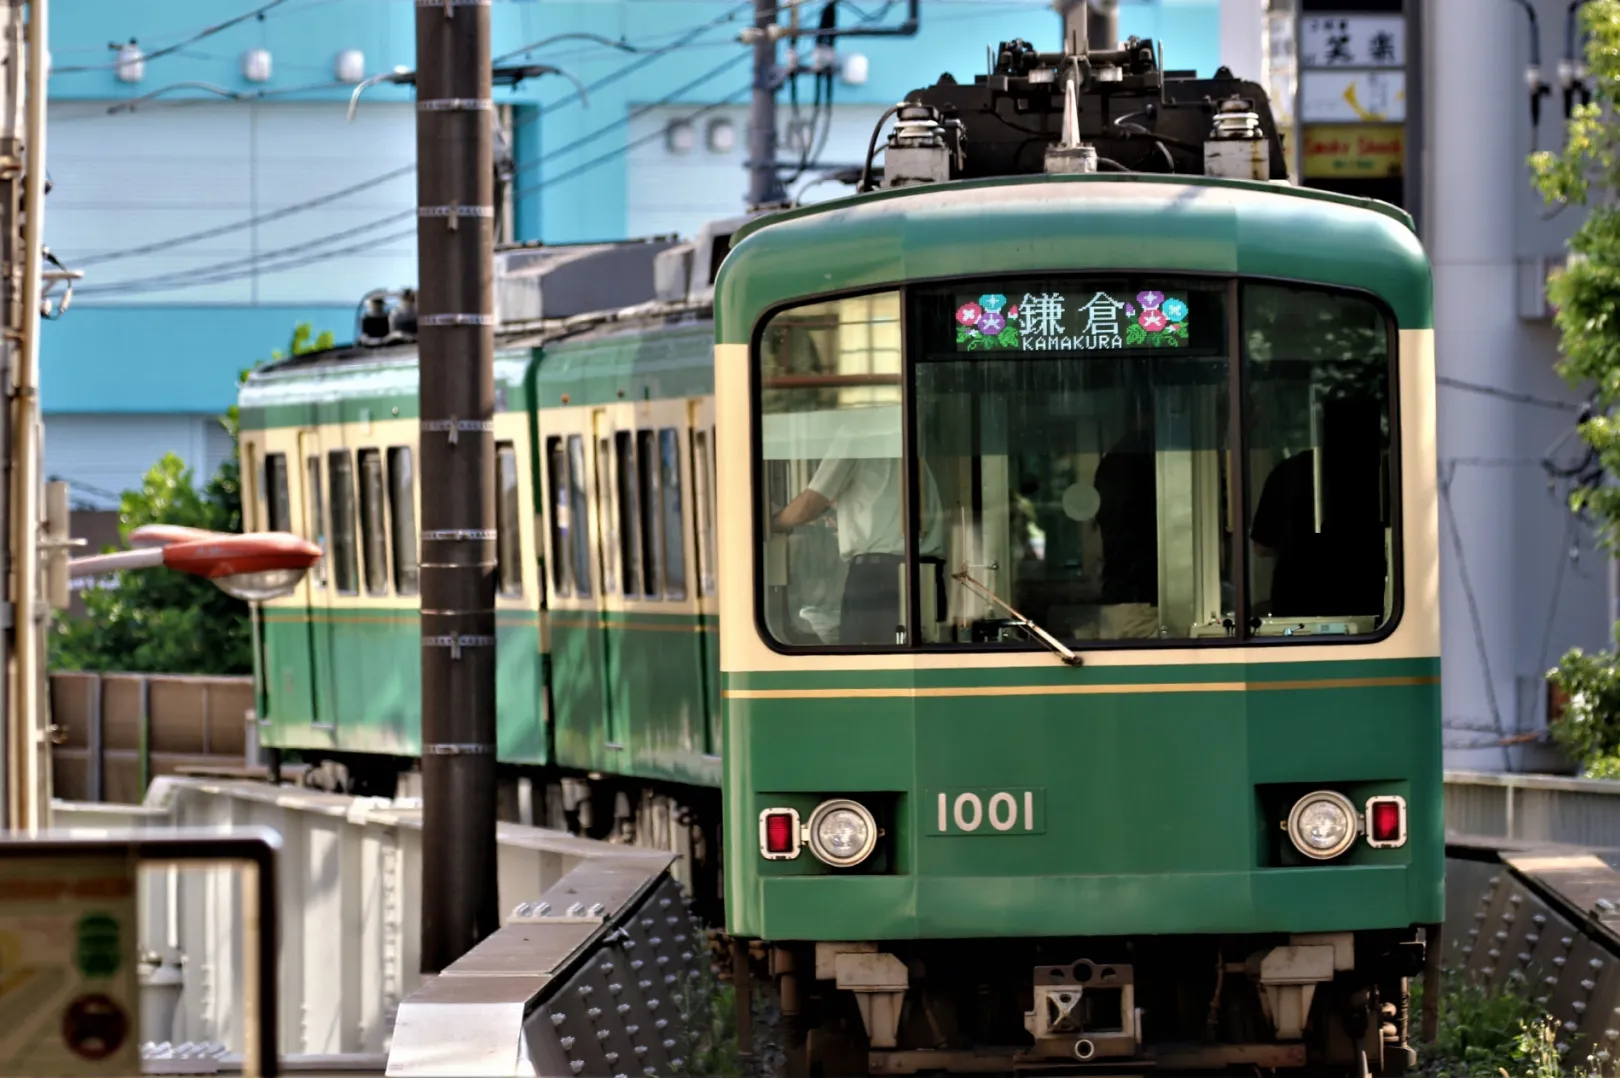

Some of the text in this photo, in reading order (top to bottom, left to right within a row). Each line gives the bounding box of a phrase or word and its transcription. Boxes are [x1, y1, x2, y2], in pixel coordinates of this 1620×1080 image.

[1019, 291, 1125, 336] 鎌倉
[1022, 335, 1123, 351] KAMAKURA
[938, 791, 1034, 832] 1001
